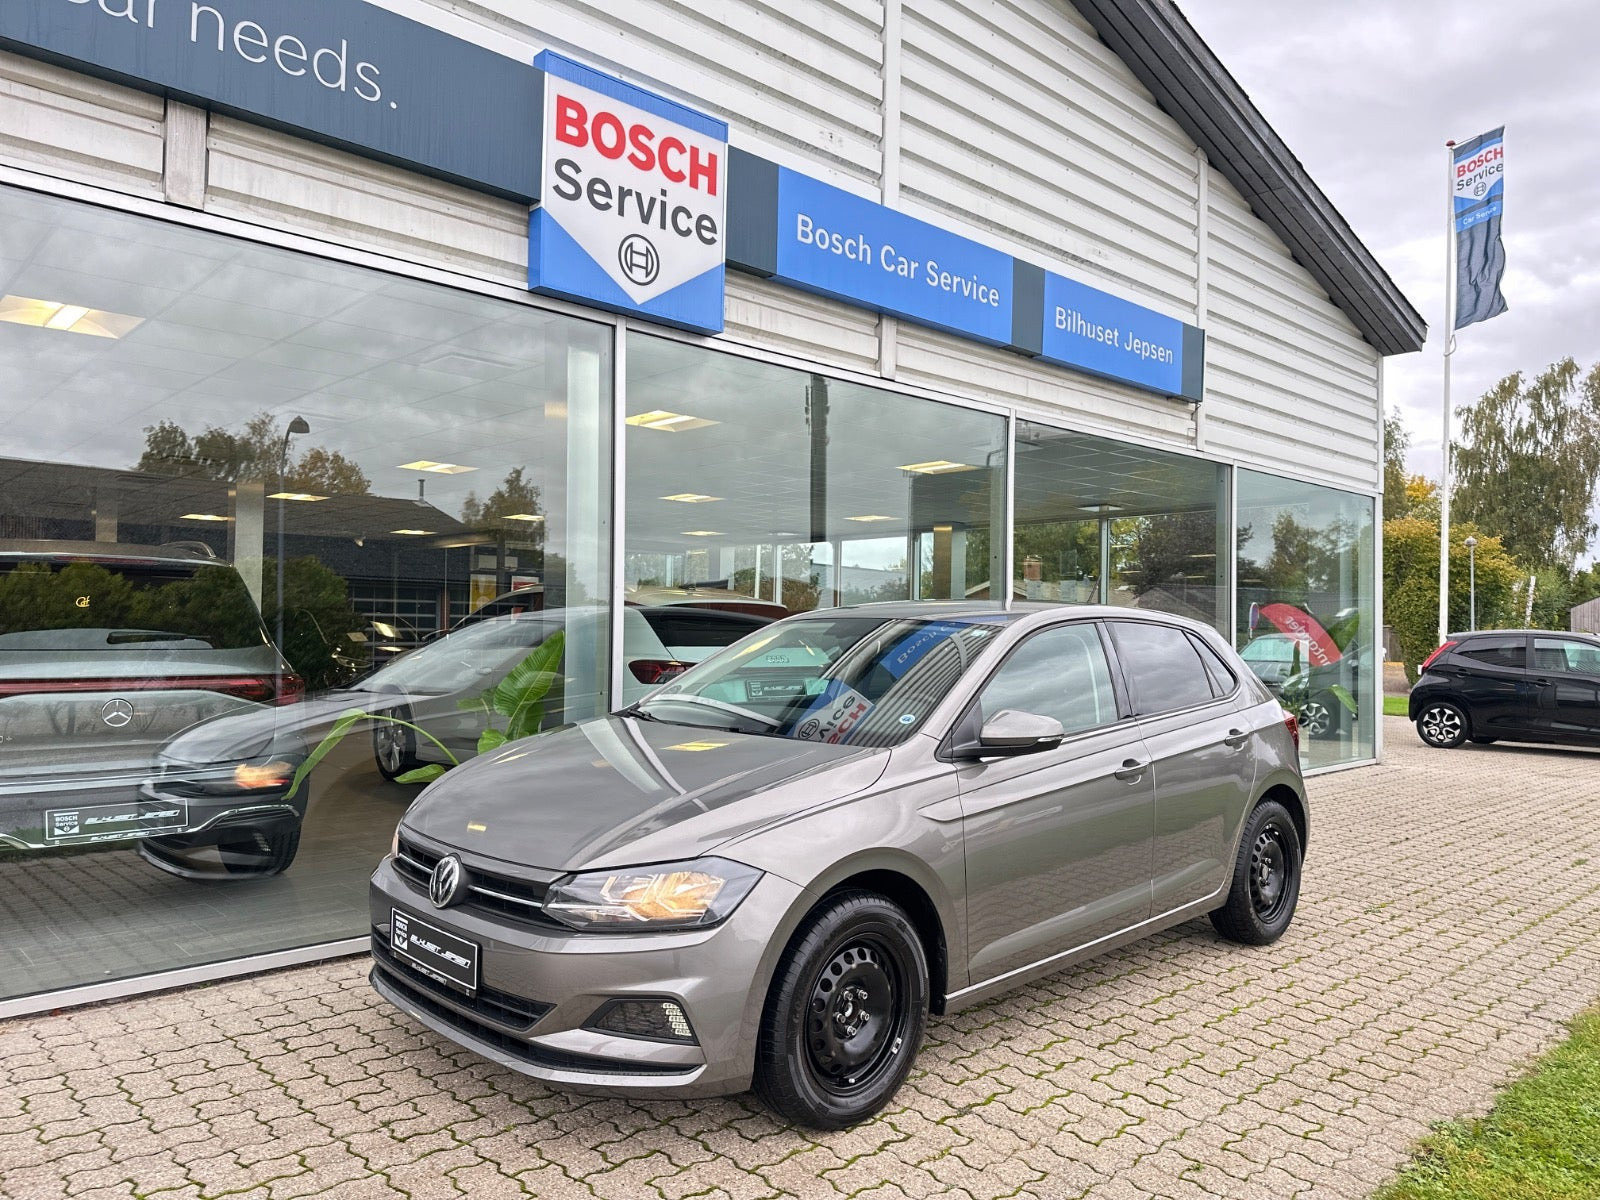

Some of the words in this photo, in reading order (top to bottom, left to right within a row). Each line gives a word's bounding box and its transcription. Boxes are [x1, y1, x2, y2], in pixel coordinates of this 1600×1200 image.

[67, 0, 157, 28] ar
[190, 1, 398, 109] needs.
[555, 94, 718, 197] BOSCH
[1456, 146, 1504, 178] BOSCH
[1456, 162, 1504, 191] Service
[552, 157, 718, 246] Service
[1463, 214, 1474, 226] Car
[796, 213, 872, 265] Bosch
[880, 243, 917, 280] Car
[926, 259, 1000, 308] Service
[1054, 306, 1120, 348] Bilhuset
[1123, 331, 1174, 365] Jepsen
